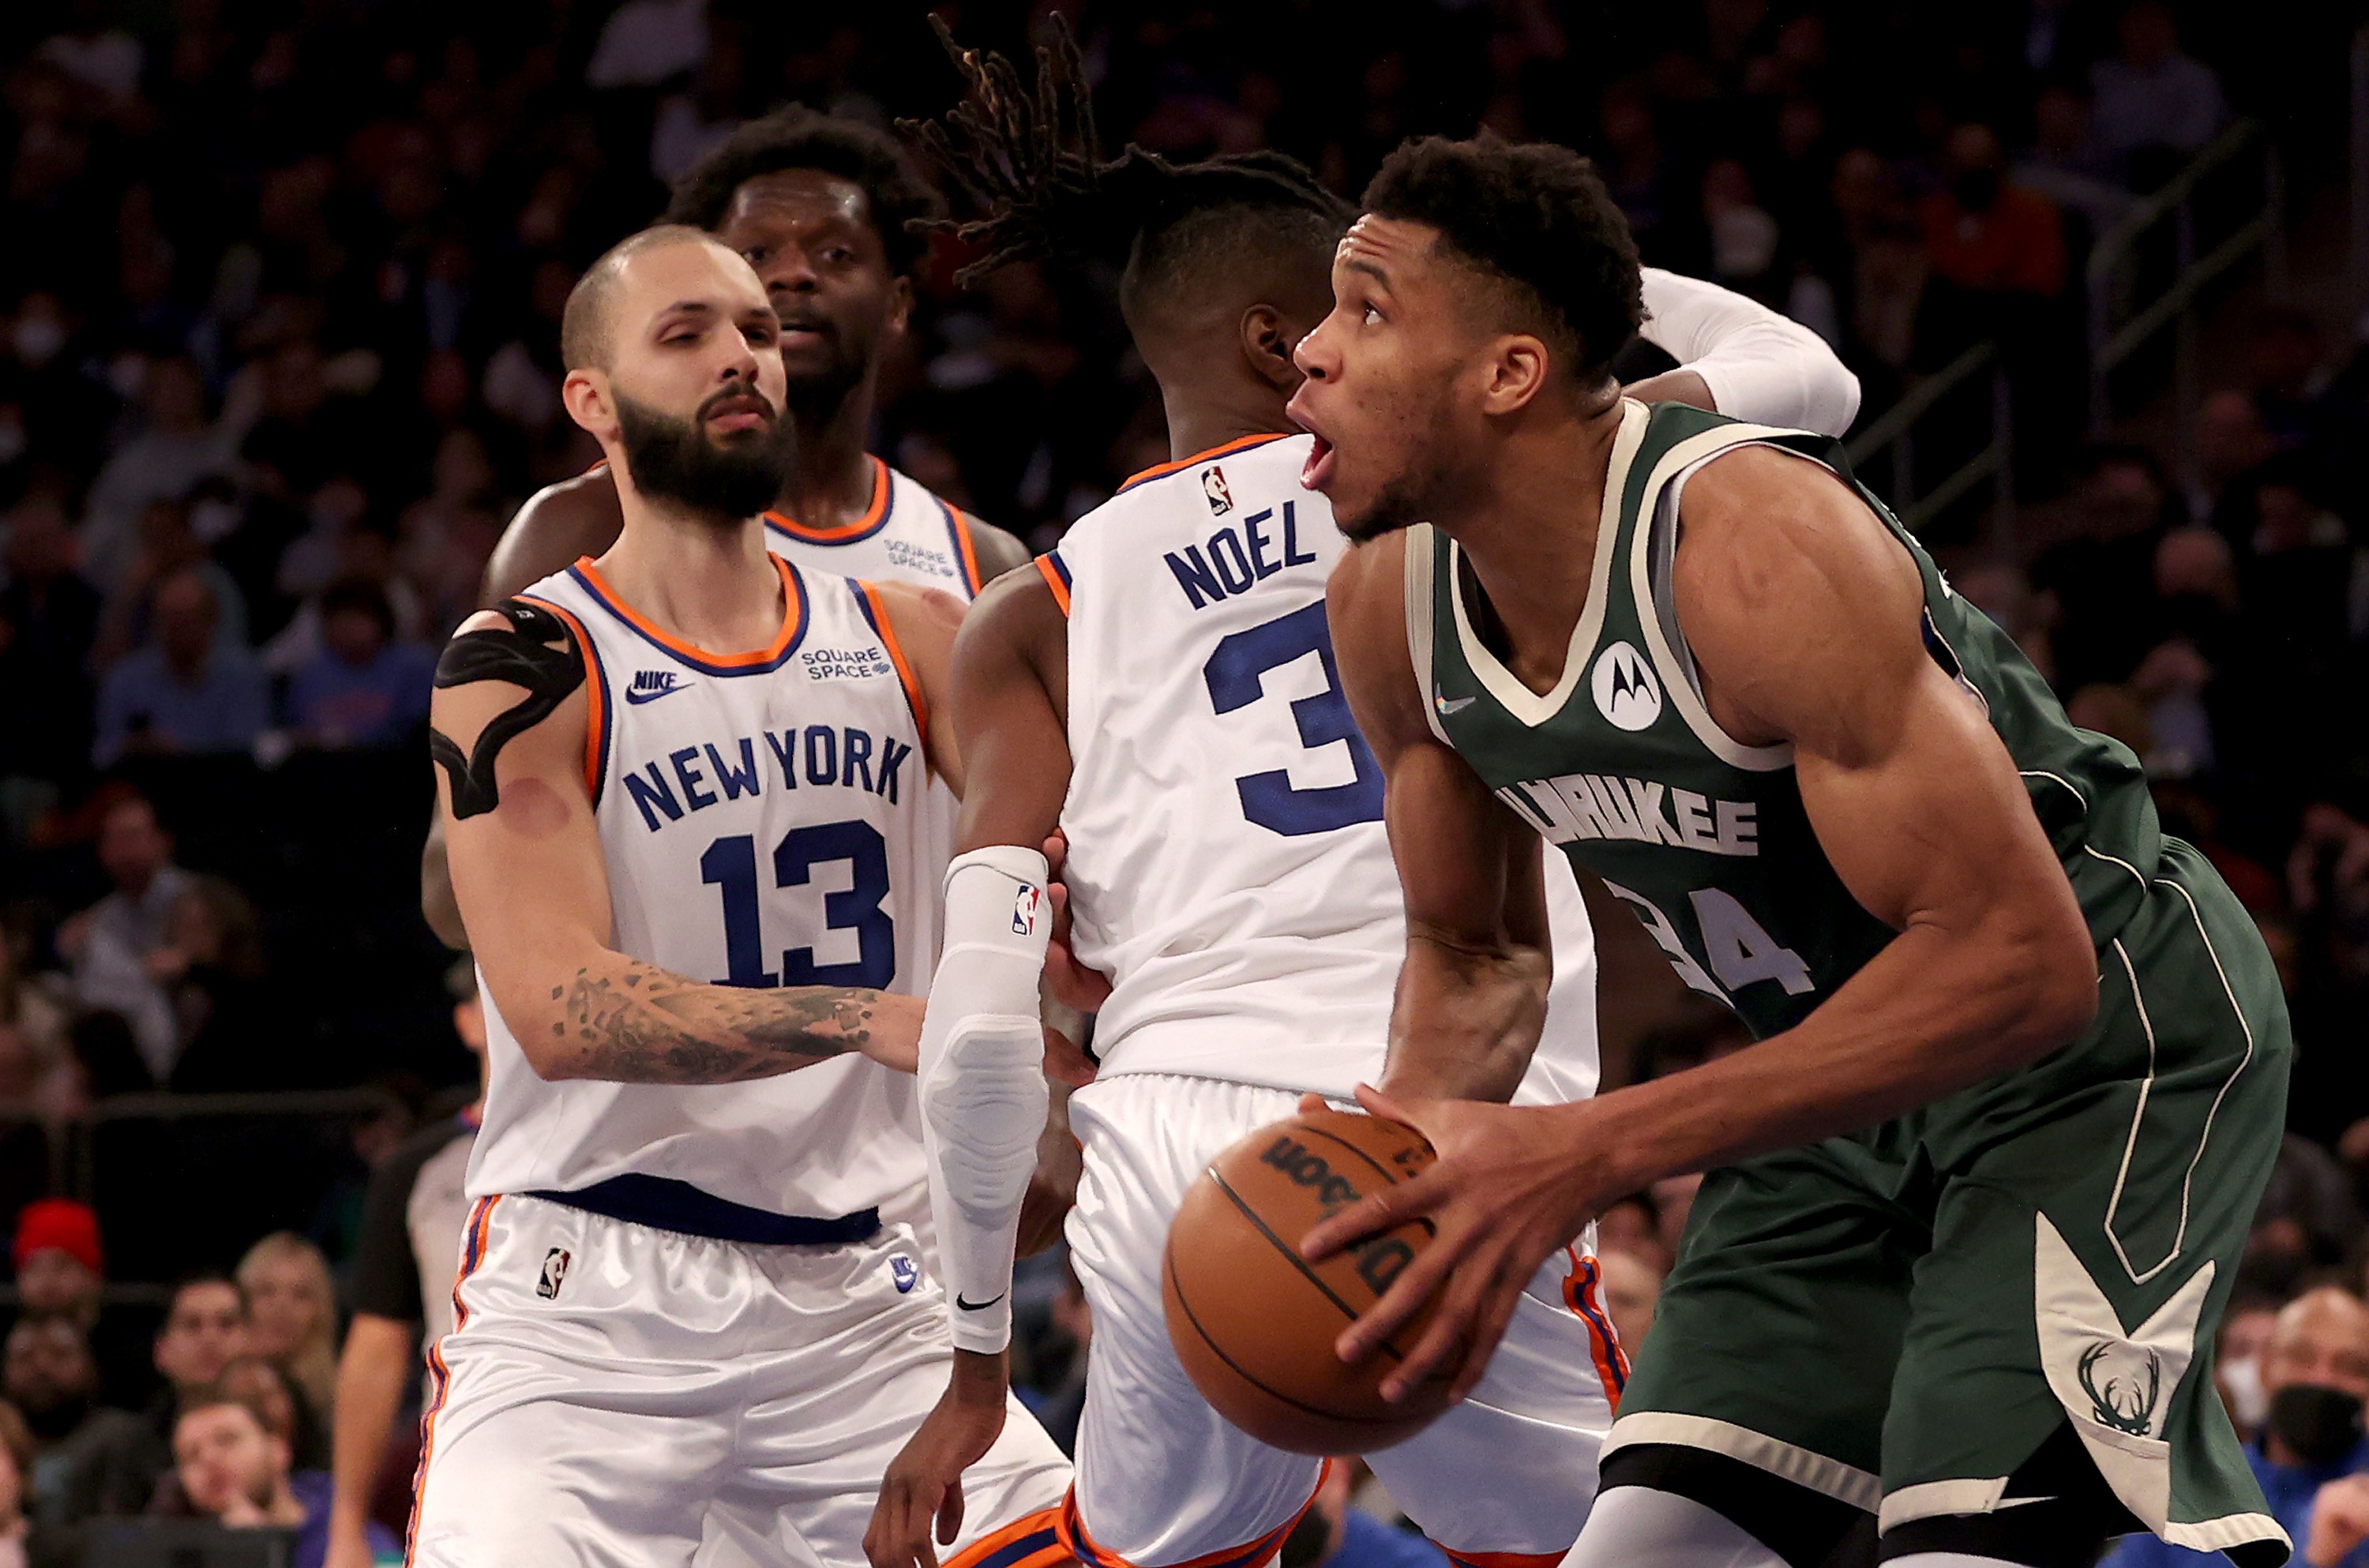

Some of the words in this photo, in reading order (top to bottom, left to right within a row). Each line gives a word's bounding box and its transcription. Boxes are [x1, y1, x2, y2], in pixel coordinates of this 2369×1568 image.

[884, 538, 947, 564] SQUARE
[888, 552, 938, 576] SPACE
[1163, 501, 1316, 610] NOEL
[633, 670, 678, 690] NIKE
[802, 647, 881, 666] SQUARE
[808, 663, 873, 680] SPACE
[1203, 598, 1387, 837] 3
[622, 737, 760, 833] NEW
[764, 725, 911, 805] YORK
[1494, 772, 1759, 857] ILWAUKEE
[700, 819, 896, 990] 13
[1601, 877, 1815, 1009] 34
